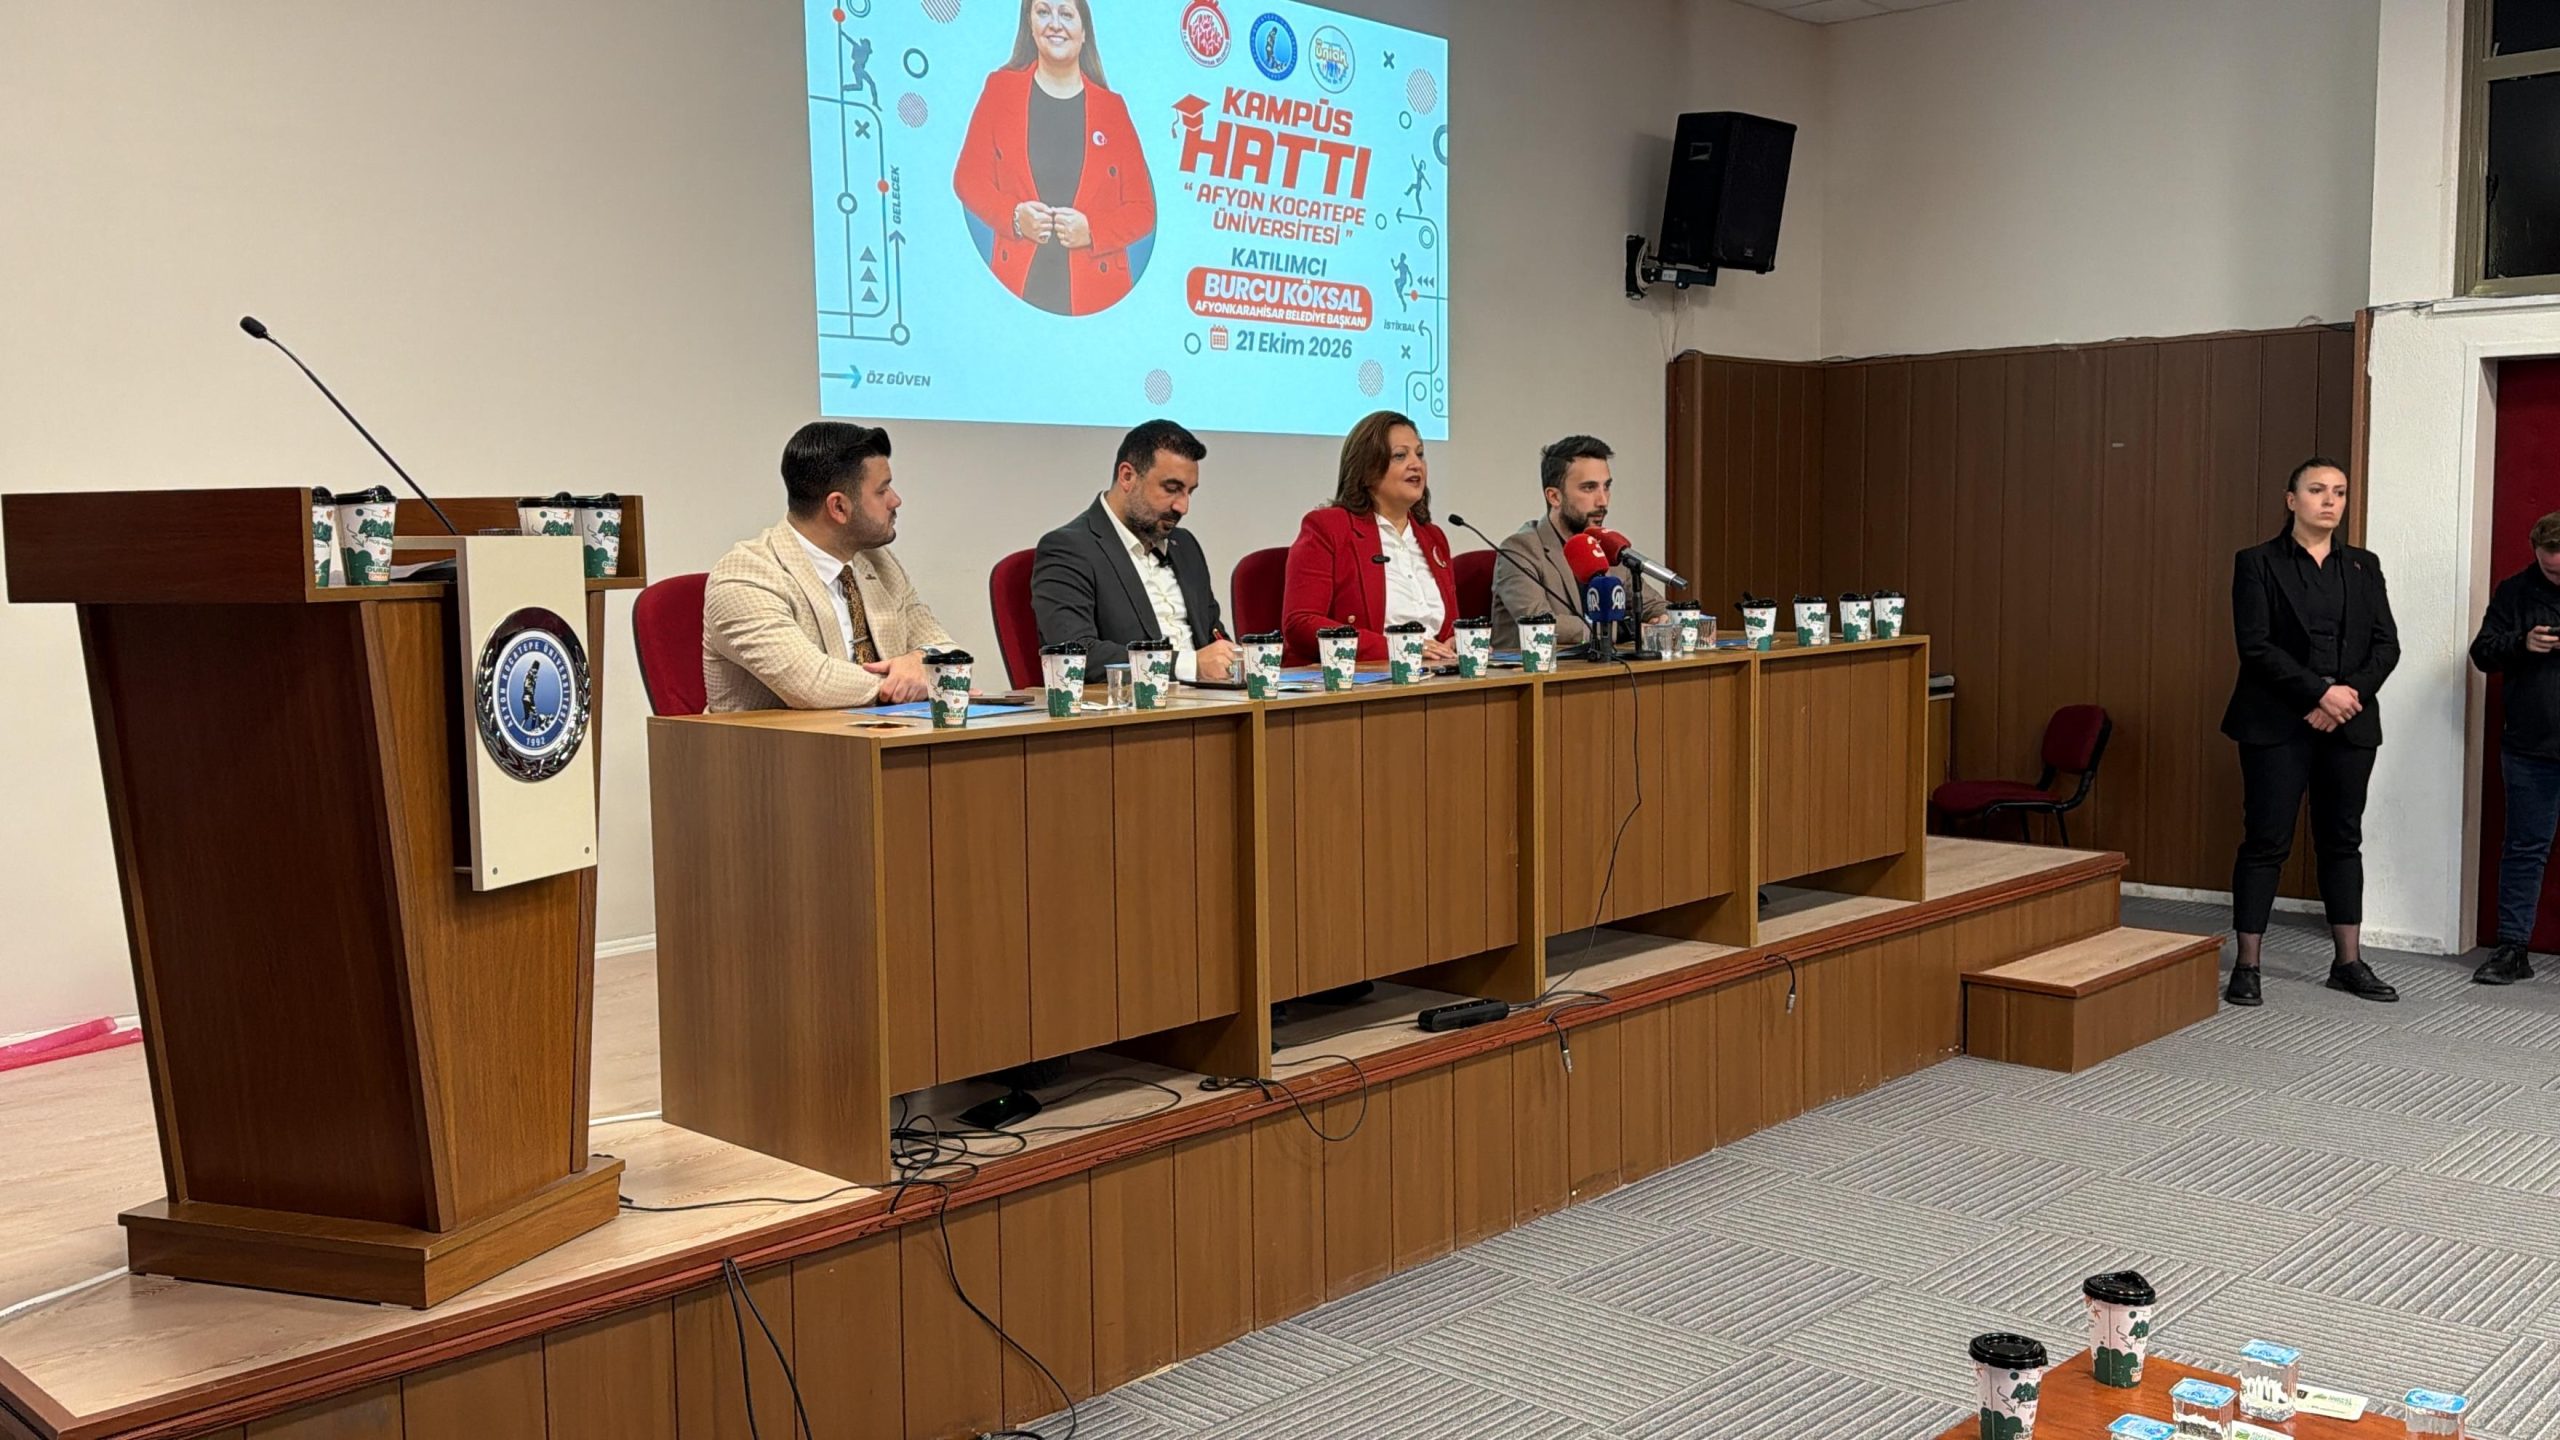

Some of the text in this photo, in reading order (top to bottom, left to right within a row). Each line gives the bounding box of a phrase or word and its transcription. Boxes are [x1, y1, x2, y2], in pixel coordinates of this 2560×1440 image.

[1222, 86, 1354, 137] KAMPÜS
[1179, 119, 1372, 200] HATTI
[890, 165, 902, 225] GELECEK
[1196, 183, 1265, 211] AFYON
[1269, 194, 1367, 226] KOCATEPE
[1213, 207, 1341, 246] ÜNİVERSİTESİ
[1231, 247, 1327, 277] KATILIMCI
[1204, 272, 1363, 313] BURCU KÖKSAL
[1194, 299, 1367, 328] AFYONKARAHİSAR BELEDİYE BAŞKANI
[1383, 319, 1416, 332] İSTİKBAL
[1235, 330, 1353, 359] 21 Ekim 2026
[866, 370, 931, 387] ÖZ GÜVEN
[499, 640, 570, 728] AFYON KOCATEPE ÜNİVERSİTESİ
[525, 736, 546, 747] 1992
